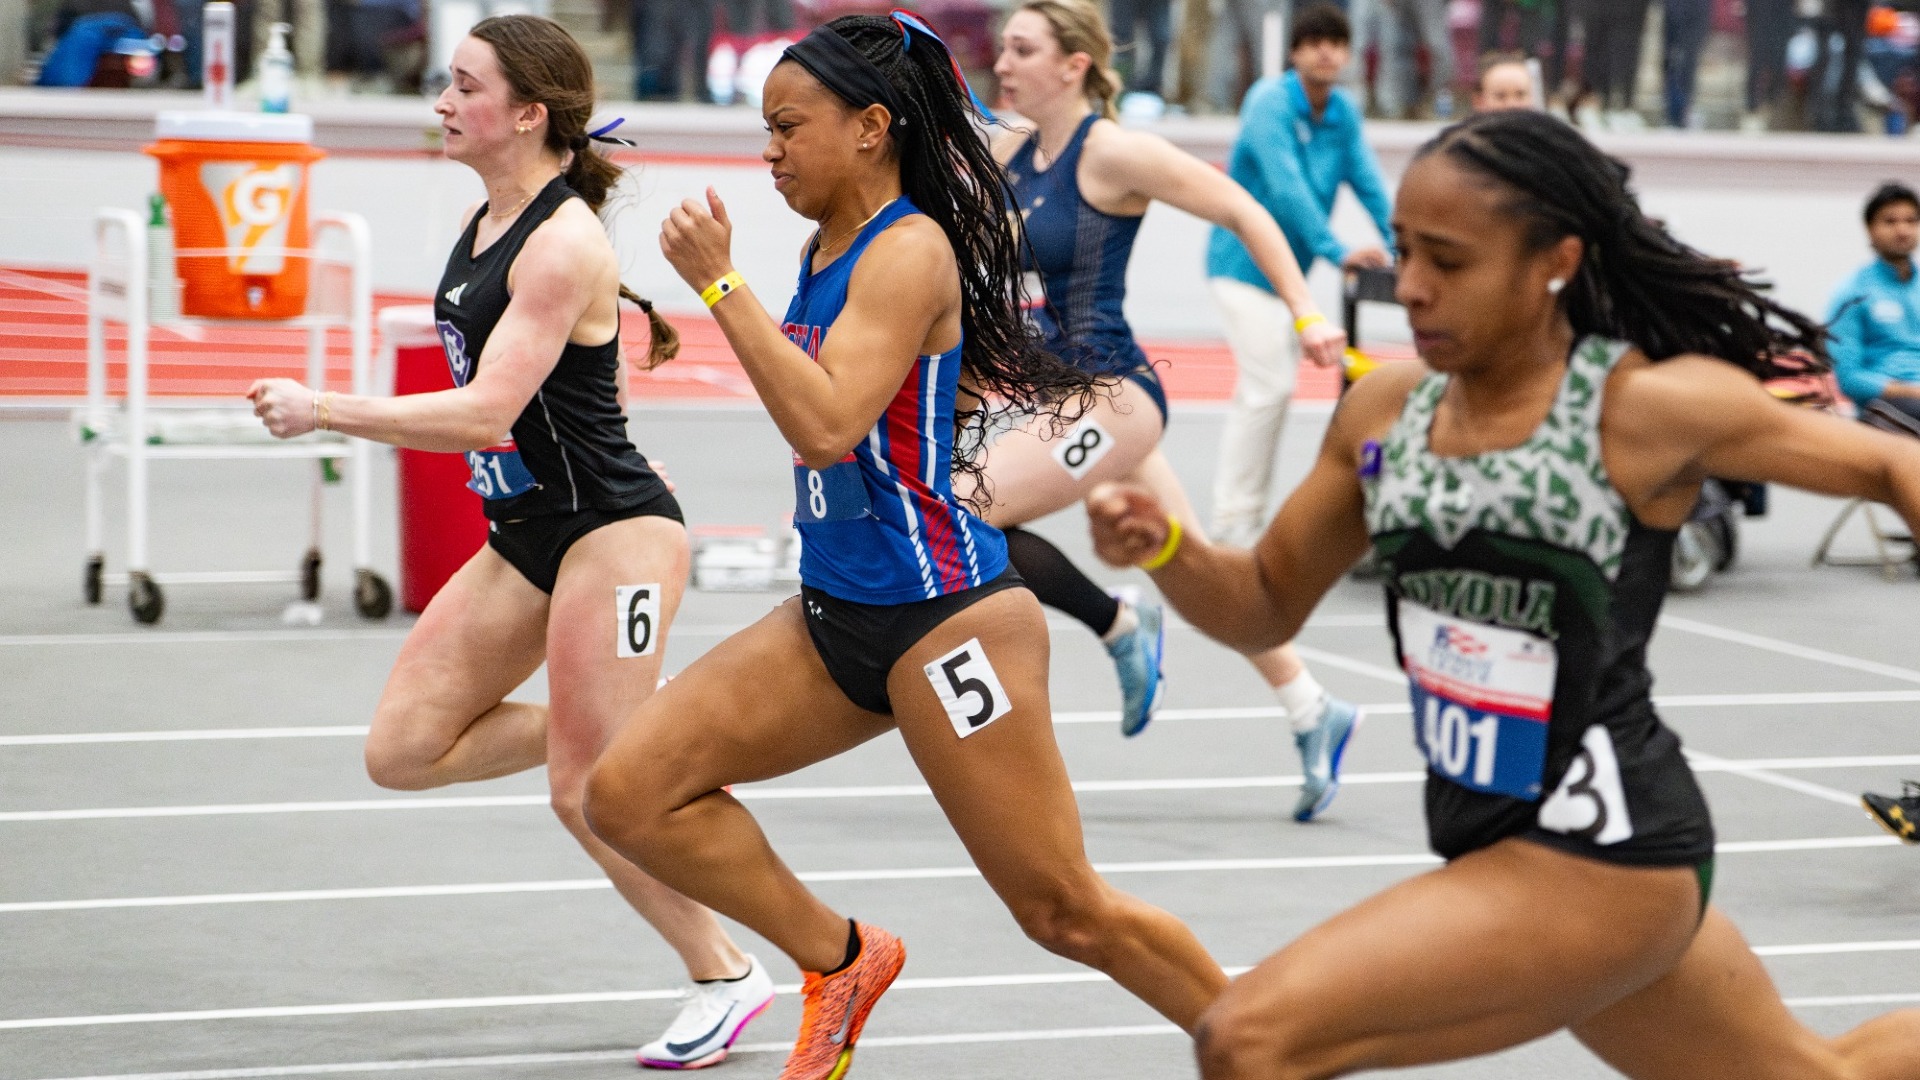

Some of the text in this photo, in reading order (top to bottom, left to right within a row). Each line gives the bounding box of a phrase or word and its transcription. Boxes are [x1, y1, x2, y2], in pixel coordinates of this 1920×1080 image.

[233, 168, 292, 226] G
[1065, 429, 1100, 467] 8
[808, 470, 827, 519] 8
[628, 589, 651, 653] 6
[1400, 569, 1558, 642] OYOLA
[941, 650, 994, 728] 5
[1560, 752, 1608, 836] 3
